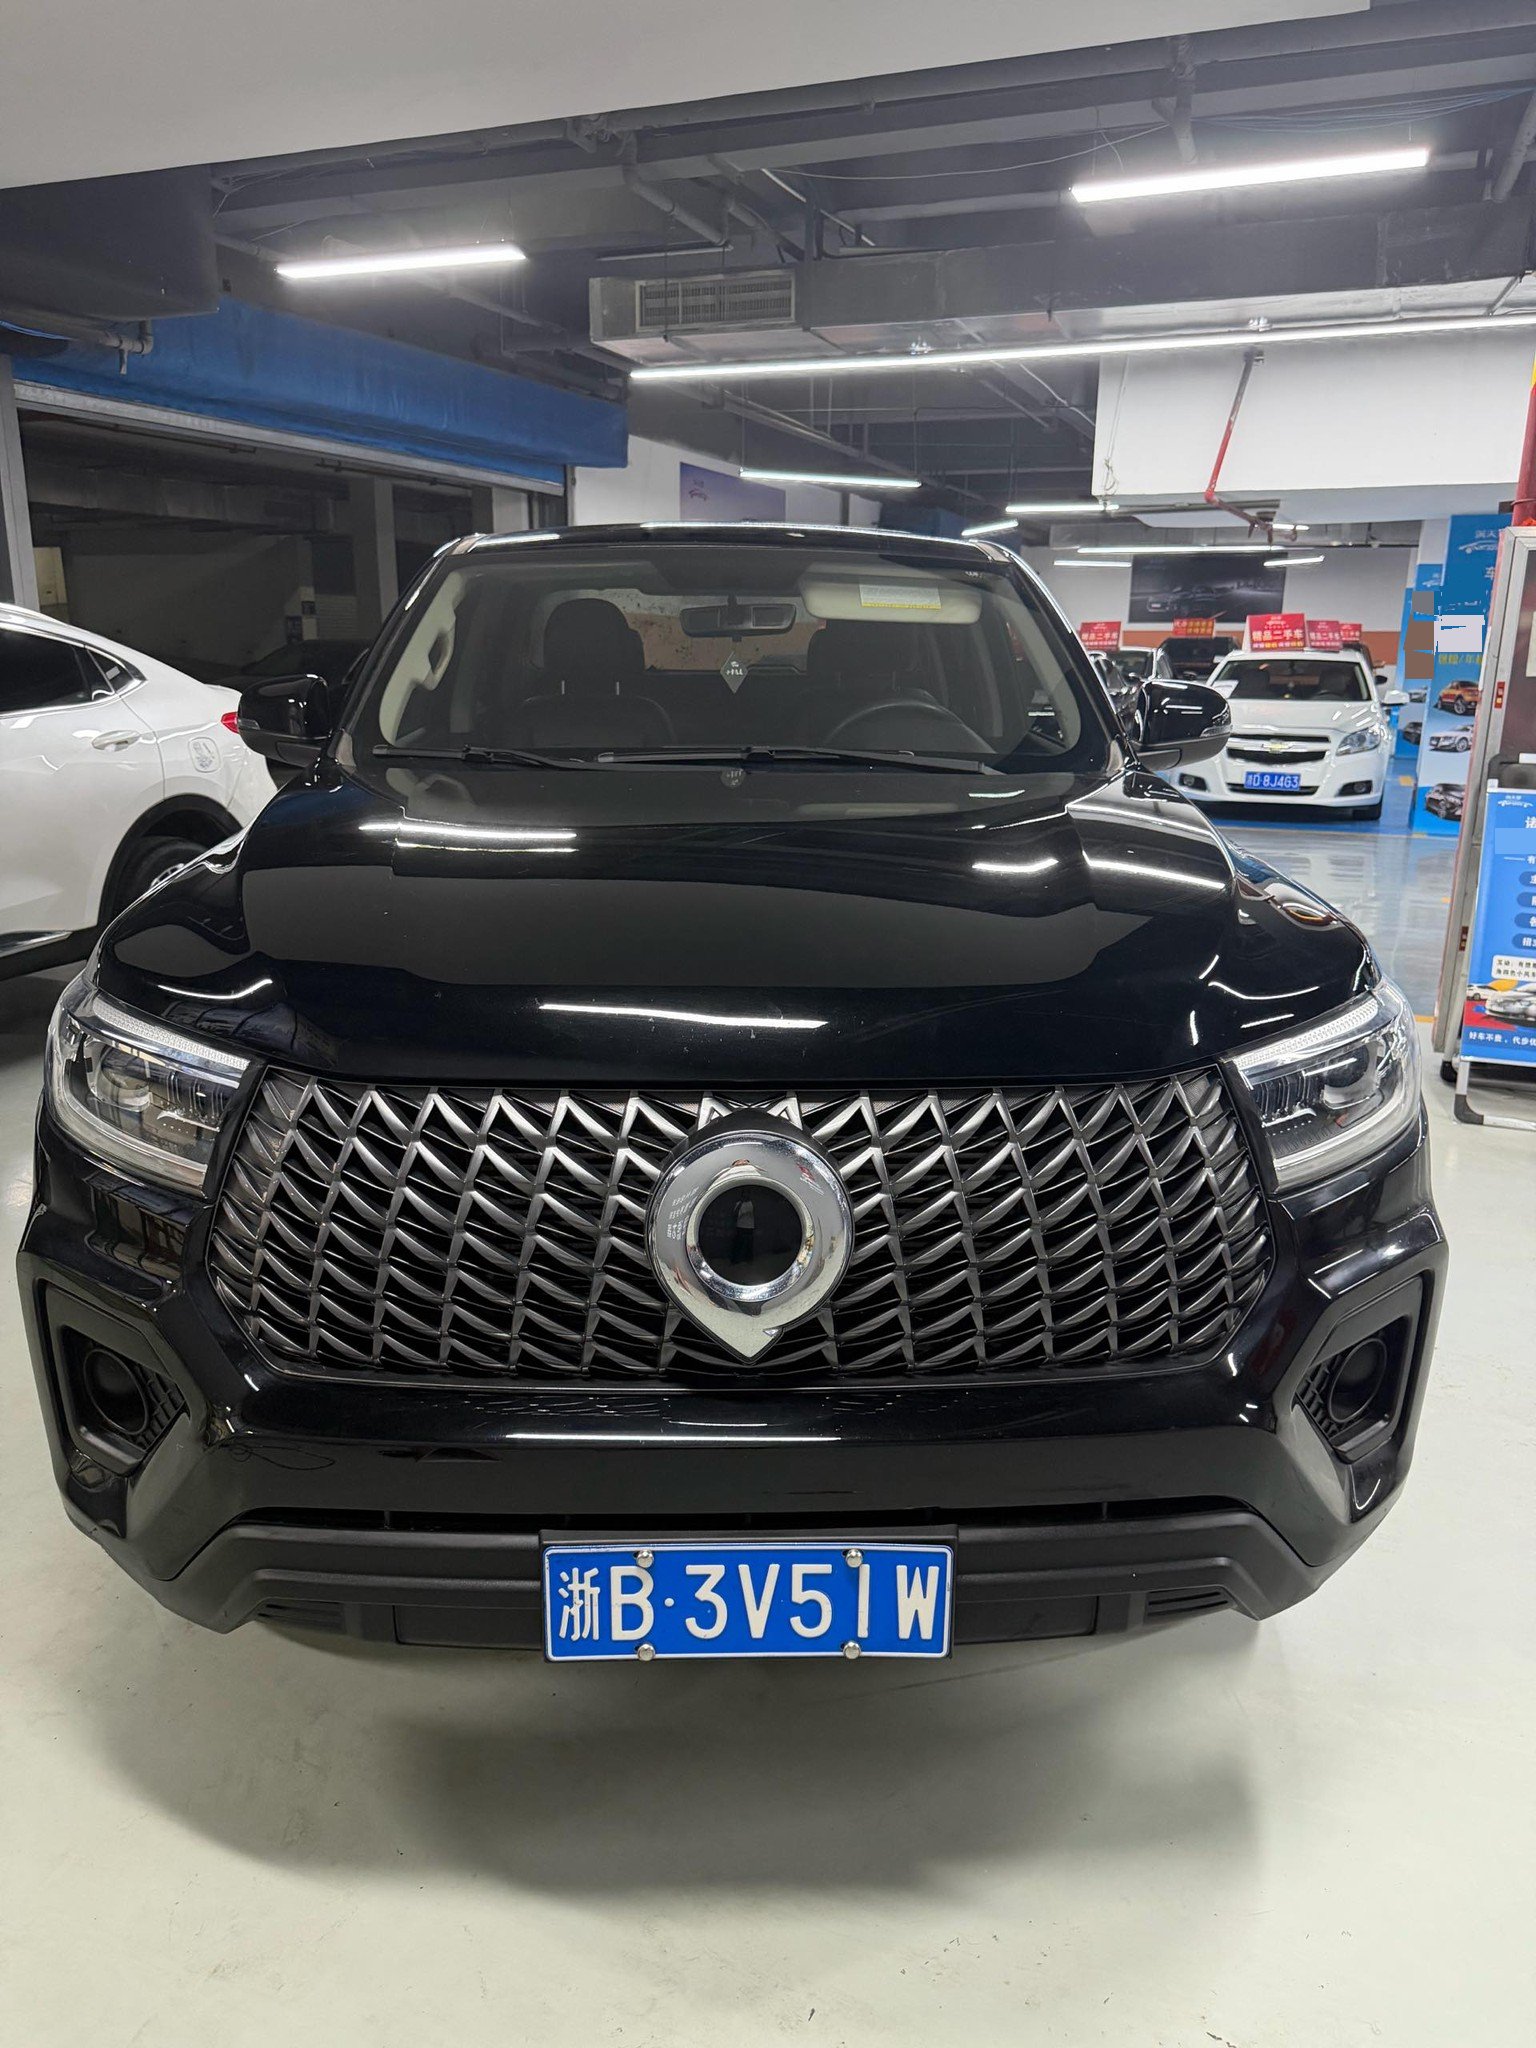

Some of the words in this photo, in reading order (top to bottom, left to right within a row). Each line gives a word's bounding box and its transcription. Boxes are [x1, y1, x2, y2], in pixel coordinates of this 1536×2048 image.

[1252, 629, 1303, 641] 精品二手车
[559, 1563, 940, 1641] 浙B·3V51W
